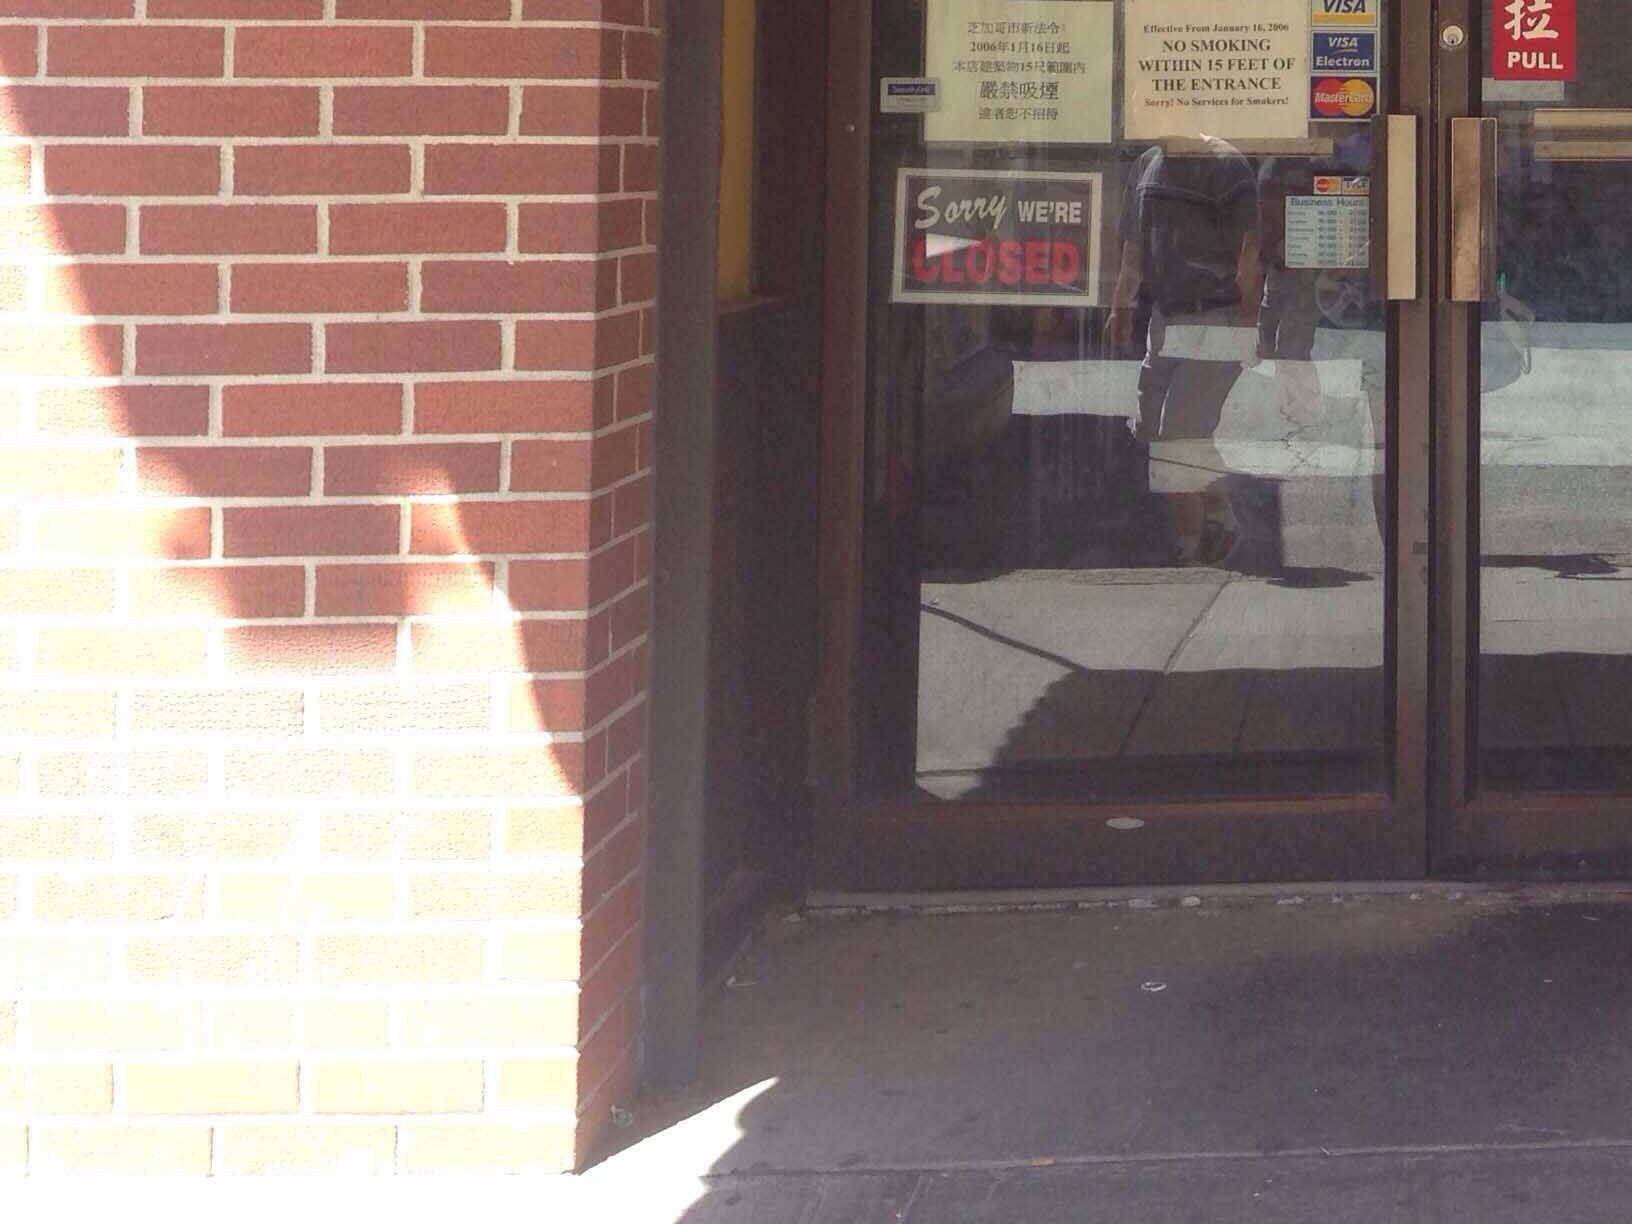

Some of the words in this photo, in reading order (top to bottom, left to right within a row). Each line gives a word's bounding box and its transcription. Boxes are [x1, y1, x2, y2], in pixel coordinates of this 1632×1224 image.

[1143, 24, 1184, 33] Effective
[1185, 24, 1210, 33] From
[1212, 23, 1250, 34] January
[1268, 22, 1289, 32] 2006
[1162, 39, 1187, 53] NO
[1190, 38, 1271, 52] SMOKING
[1328, 37, 1359, 48] VISA
[1138, 59, 1202, 72] WITHIN
[1207, 58, 1223, 72] 15
[1227, 58, 1270, 71] FEET
[1273, 57, 1296, 71] OF
[1316, 56, 1370, 67] Electron
[1507, 51, 1564, 70] PULL
[1152, 78, 1186, 92] THE
[1190, 77, 1282, 91] ENTRANCE
[1144, 97, 1174, 108] Sorry!
[1176, 97, 1190, 107] No
[1191, 97, 1229, 106] Services
[1231, 96, 1245, 106] for
[914, 185, 1008, 230] Sorry
[1017, 200, 1082, 224] WE'RE
[912, 235, 1082, 285] CLOSED
